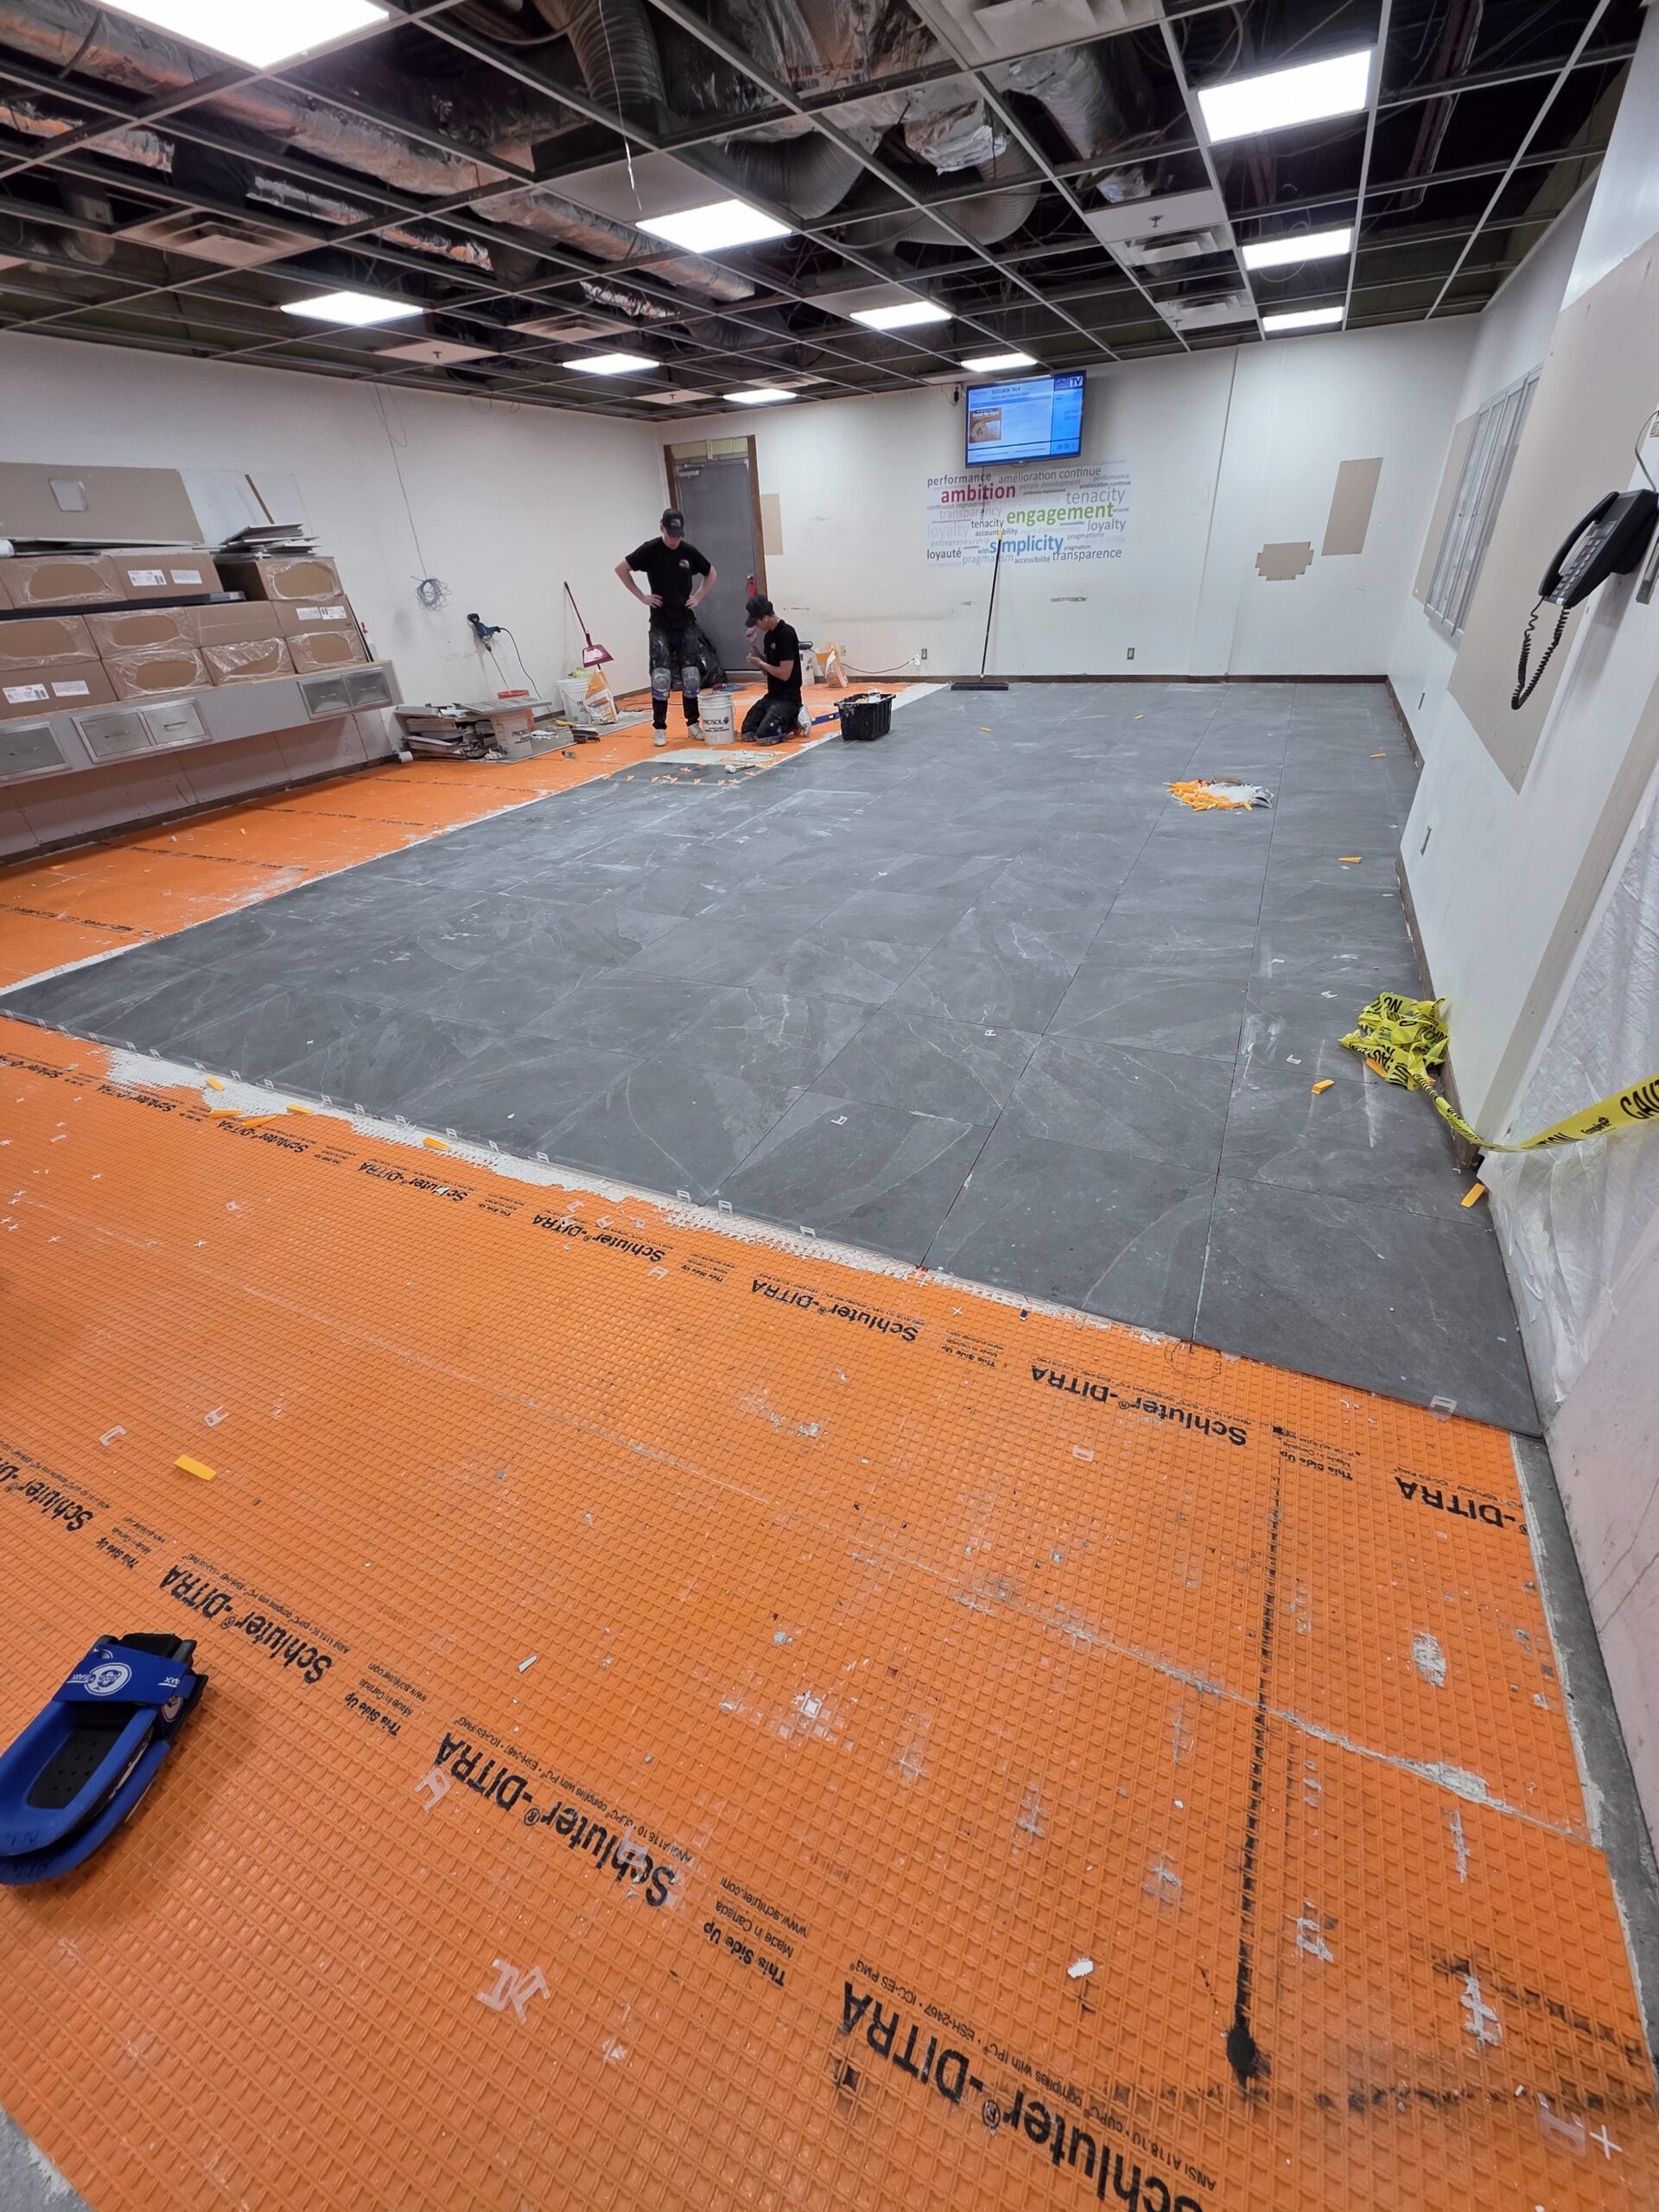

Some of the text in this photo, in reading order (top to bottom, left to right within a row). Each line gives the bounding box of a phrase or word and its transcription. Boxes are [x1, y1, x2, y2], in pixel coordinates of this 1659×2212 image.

[1071, 377, 1082, 386] TV
[927, 473, 992, 488] performance
[998, 467, 1102, 484] amélioration continue
[941, 482, 1016, 503] ambition
[1065, 486, 1126, 505] tenacity
[971, 518, 1004, 529] tenacity
[1007, 501, 1115, 527] engagement
[975, 528, 1018, 537] accountbility
[1088, 518, 1127, 533] loyalty
[927, 547, 962, 561] loyauté
[989, 534, 1064, 556] smplicity
[1052, 549, 1122, 563] transparence
[963, 554, 1014, 566] pragmasm
[344, 1693, 401, 1737] This Side Up
[715, 1900, 753, 1932] Canada
[720, 1878, 807, 1938] www.schluter.com
[703, 1922, 785, 1986] This Side Up
[765, 1932, 794, 1959] Made
[923, 2000, 974, 2043] ESH-2467
[1010, 2055, 1033, 2080] with
[1033, 2066, 1083, 2110] complies
[1131, 2130, 1181, 2171] A118.10
[1181, 2161, 1216, 2193] ANSI
